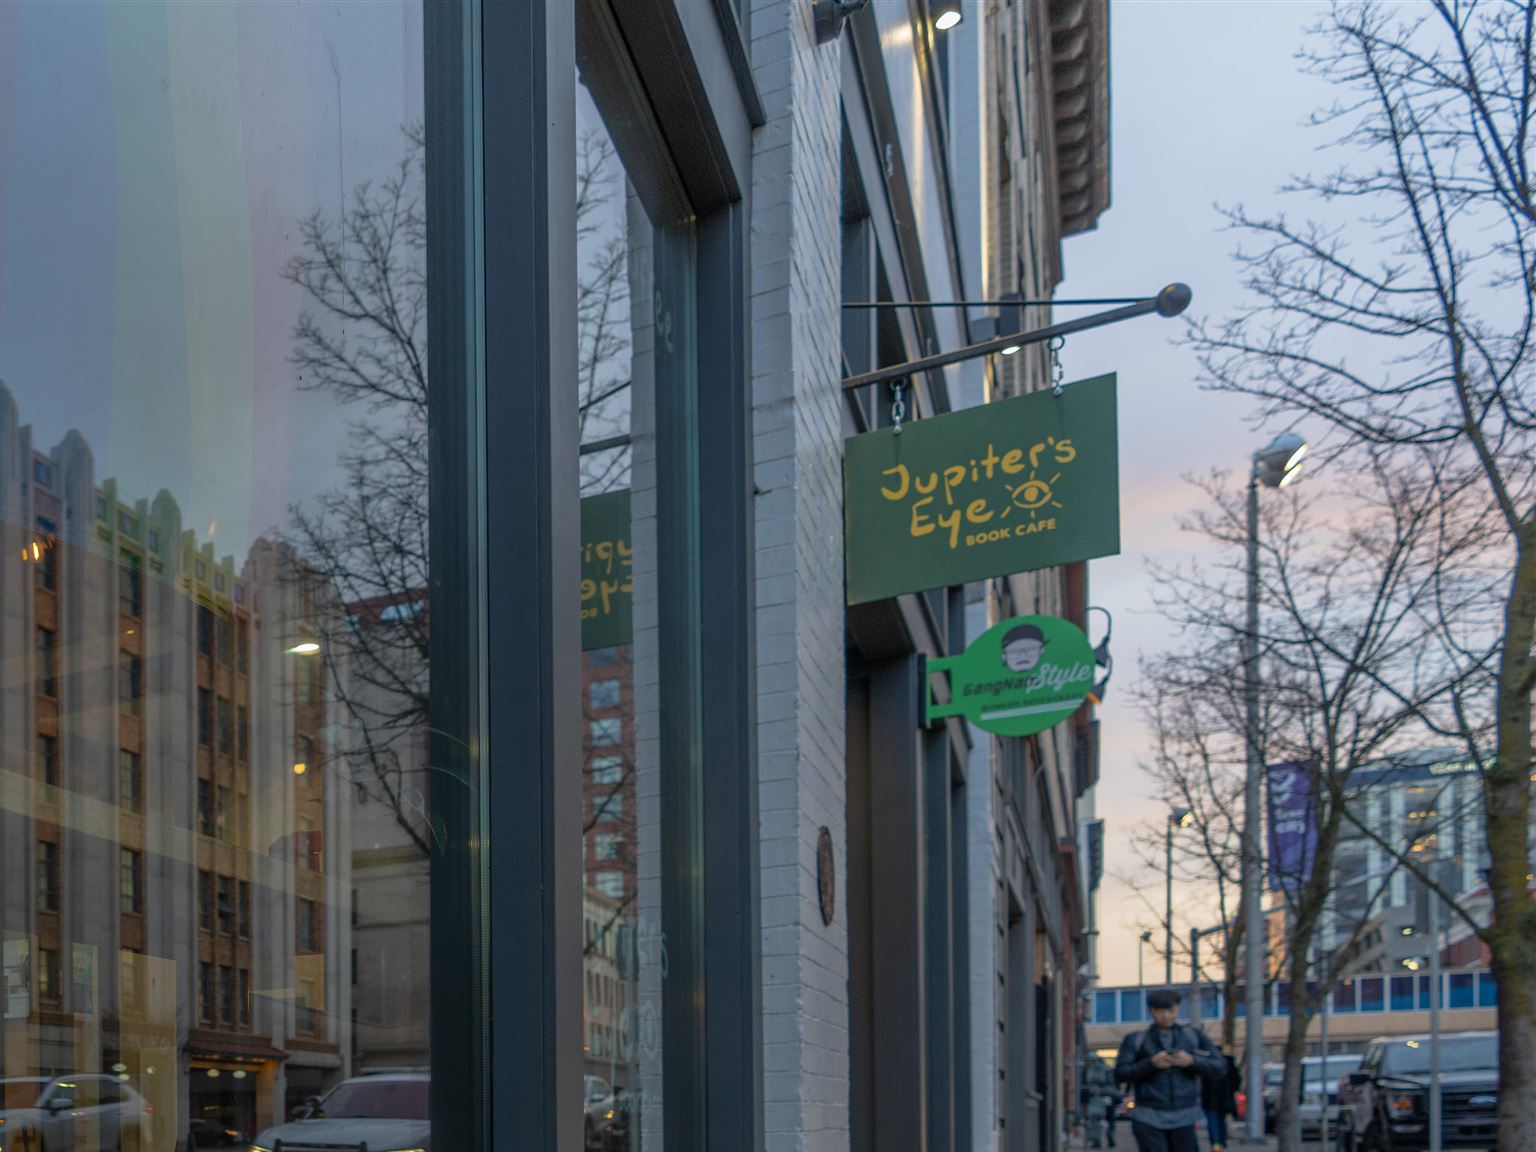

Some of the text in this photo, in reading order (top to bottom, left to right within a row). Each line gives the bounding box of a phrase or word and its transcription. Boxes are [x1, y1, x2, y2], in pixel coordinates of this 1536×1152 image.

[880, 436, 1077, 506] Jupiter's
[910, 496, 996, 550] Eye
[965, 517, 1058, 547] BOOK CAFE
[1025, 661, 1092, 695] Style
